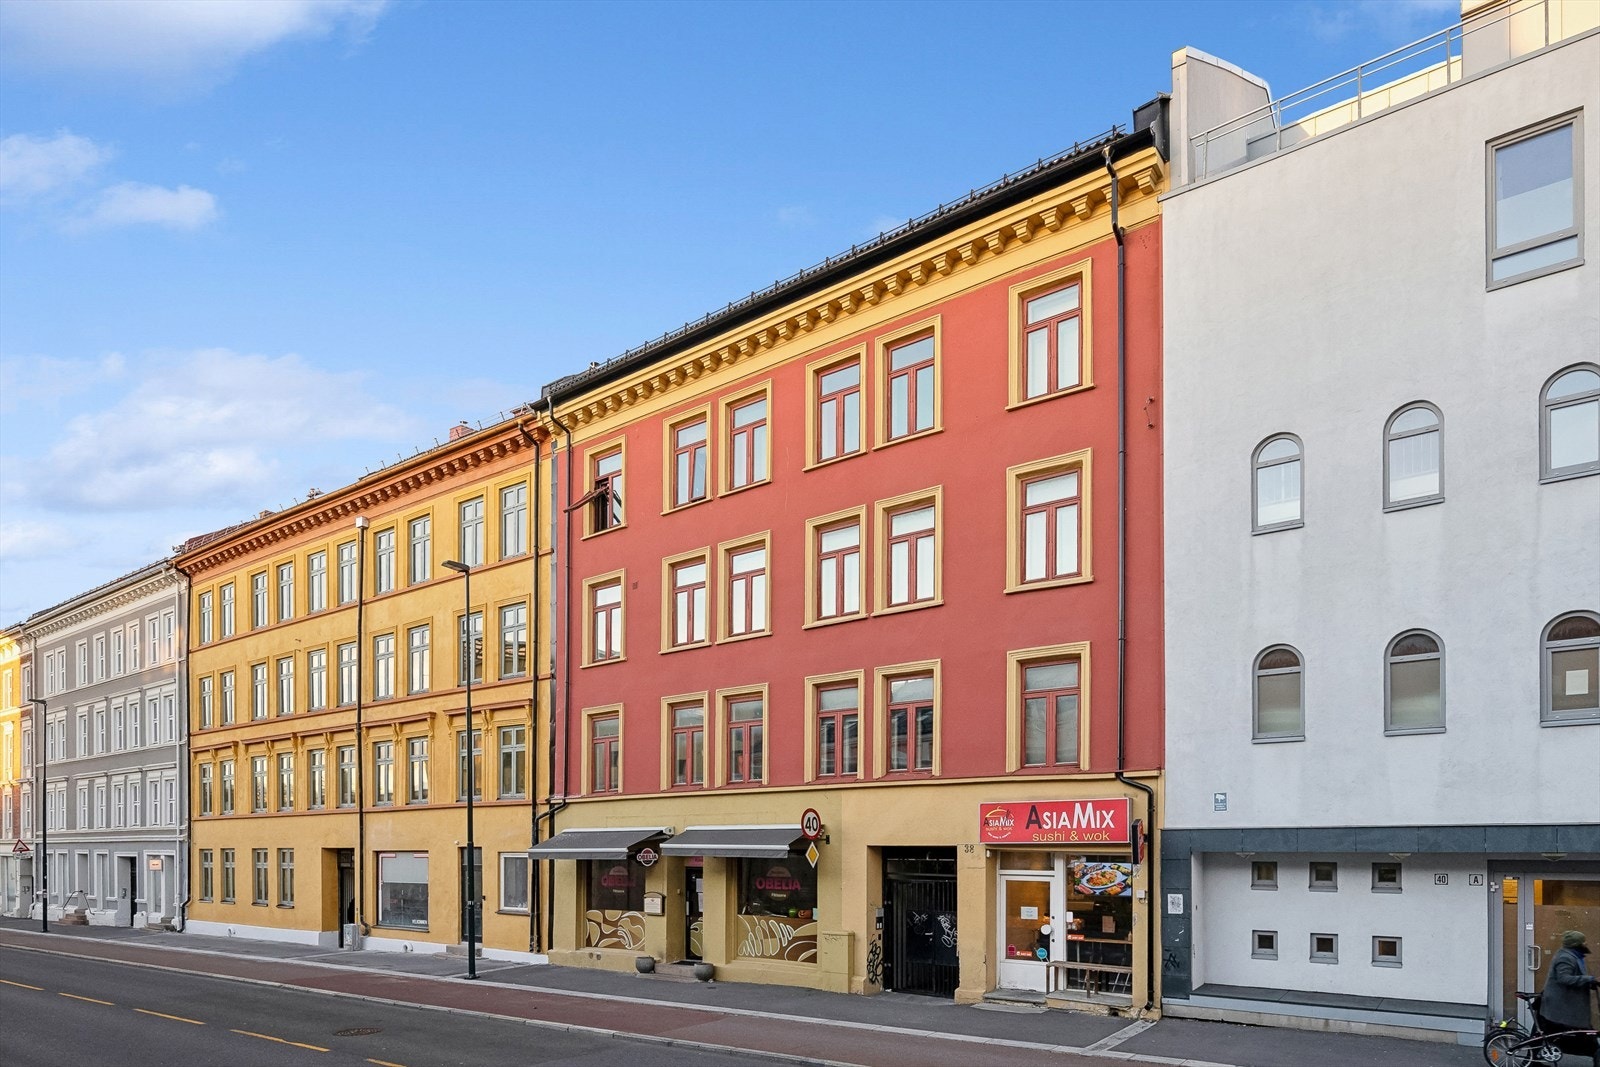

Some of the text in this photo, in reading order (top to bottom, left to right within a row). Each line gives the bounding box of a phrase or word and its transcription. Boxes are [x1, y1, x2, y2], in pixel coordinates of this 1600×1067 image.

[805, 816, 818, 832] 40
[1032, 830, 1110, 842] sushi & wok
[964, 844, 974, 853] 38
[637, 853, 658, 861] OBELIA
[755, 877, 801, 891] OBELIA
[1437, 875, 1446, 884] 40
[1473, 875, 1479, 884] A
